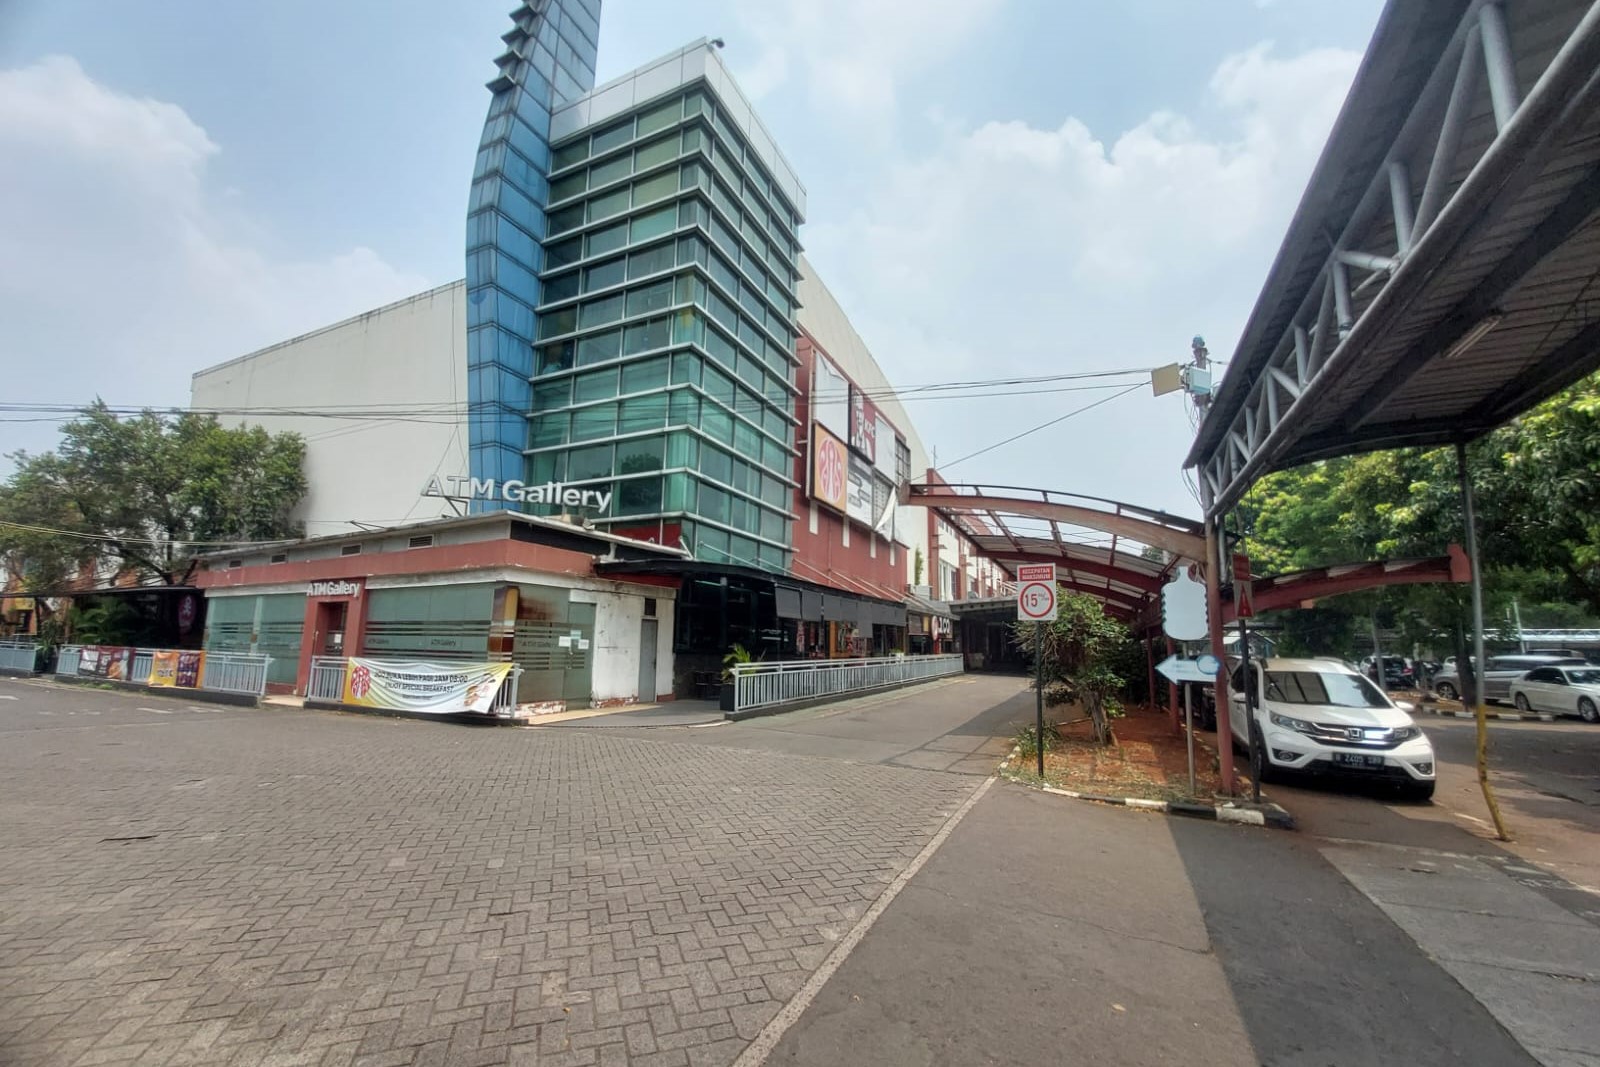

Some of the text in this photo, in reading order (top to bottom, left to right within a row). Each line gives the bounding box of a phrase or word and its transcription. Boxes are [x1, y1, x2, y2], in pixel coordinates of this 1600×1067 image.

[420, 473, 613, 514] ATM Gallery
[306, 580, 360, 598] ATM Gallery
[1025, 593, 1038, 607] 15
[423, 684, 455, 693] BREAKFAST
